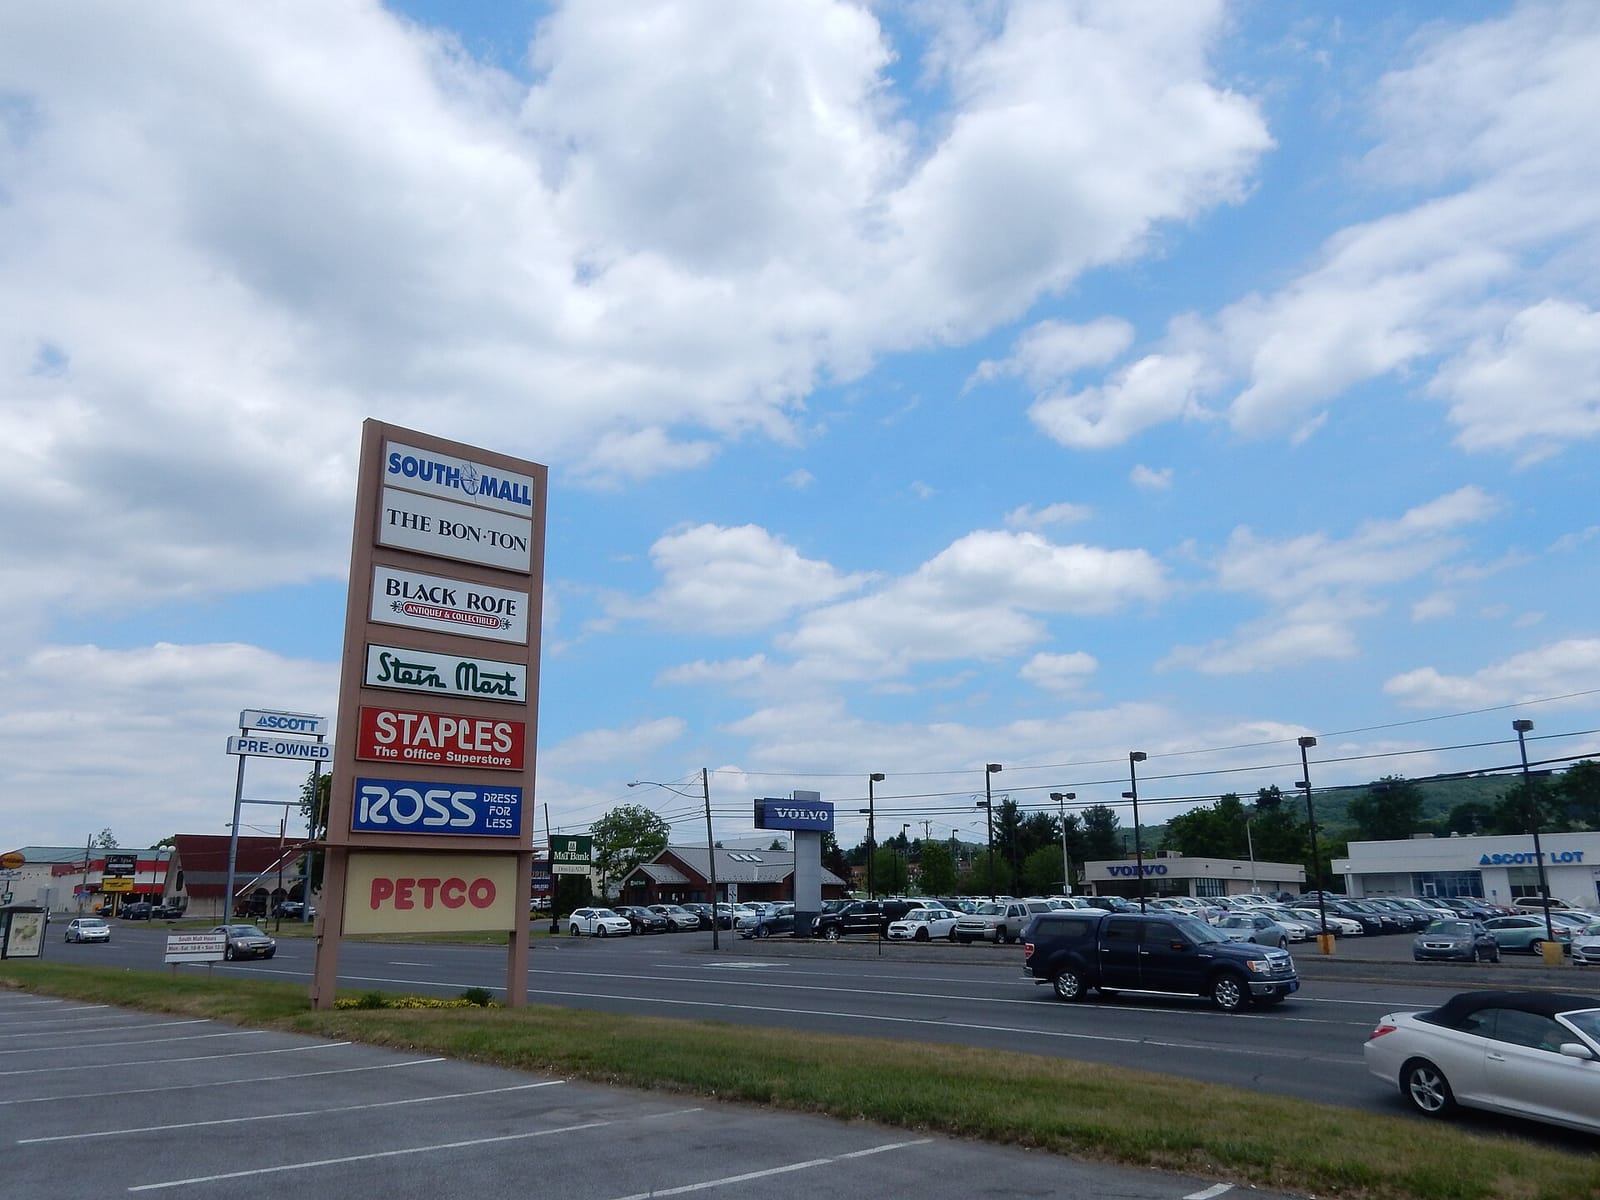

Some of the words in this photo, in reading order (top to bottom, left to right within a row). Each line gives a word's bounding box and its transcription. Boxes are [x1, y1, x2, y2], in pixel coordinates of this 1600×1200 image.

[388, 452, 460, 489] SOUTH
[479, 475, 531, 506] MALL
[387, 508, 432, 533] THE
[386, 578, 457, 607] BLACK
[467, 592, 517, 617] ROSE
[407, 605, 443, 618] ANTIQUES
[444, 611, 450, 619] &
[452, 612, 496, 626] COLLECTIBLES
[377, 652, 447, 689] Stein
[455, 662, 518, 697] Mart
[374, 711, 513, 753] STAPLES
[237, 739, 329, 758] PRE-OWNED
[373, 745, 398, 758] The
[403, 747, 441, 761] Office
[446, 751, 512, 766] Superstore
[359, 785, 477, 827] ROSS
[483, 792, 518, 804] DRESS
[489, 806, 511, 816] FOR
[774, 807, 829, 821] VOLVO
[485, 818, 513, 829] LESS
[571, 851, 590, 861] Bank
[1550, 851, 1585, 863] LOT
[370, 877, 497, 910] PETCO
